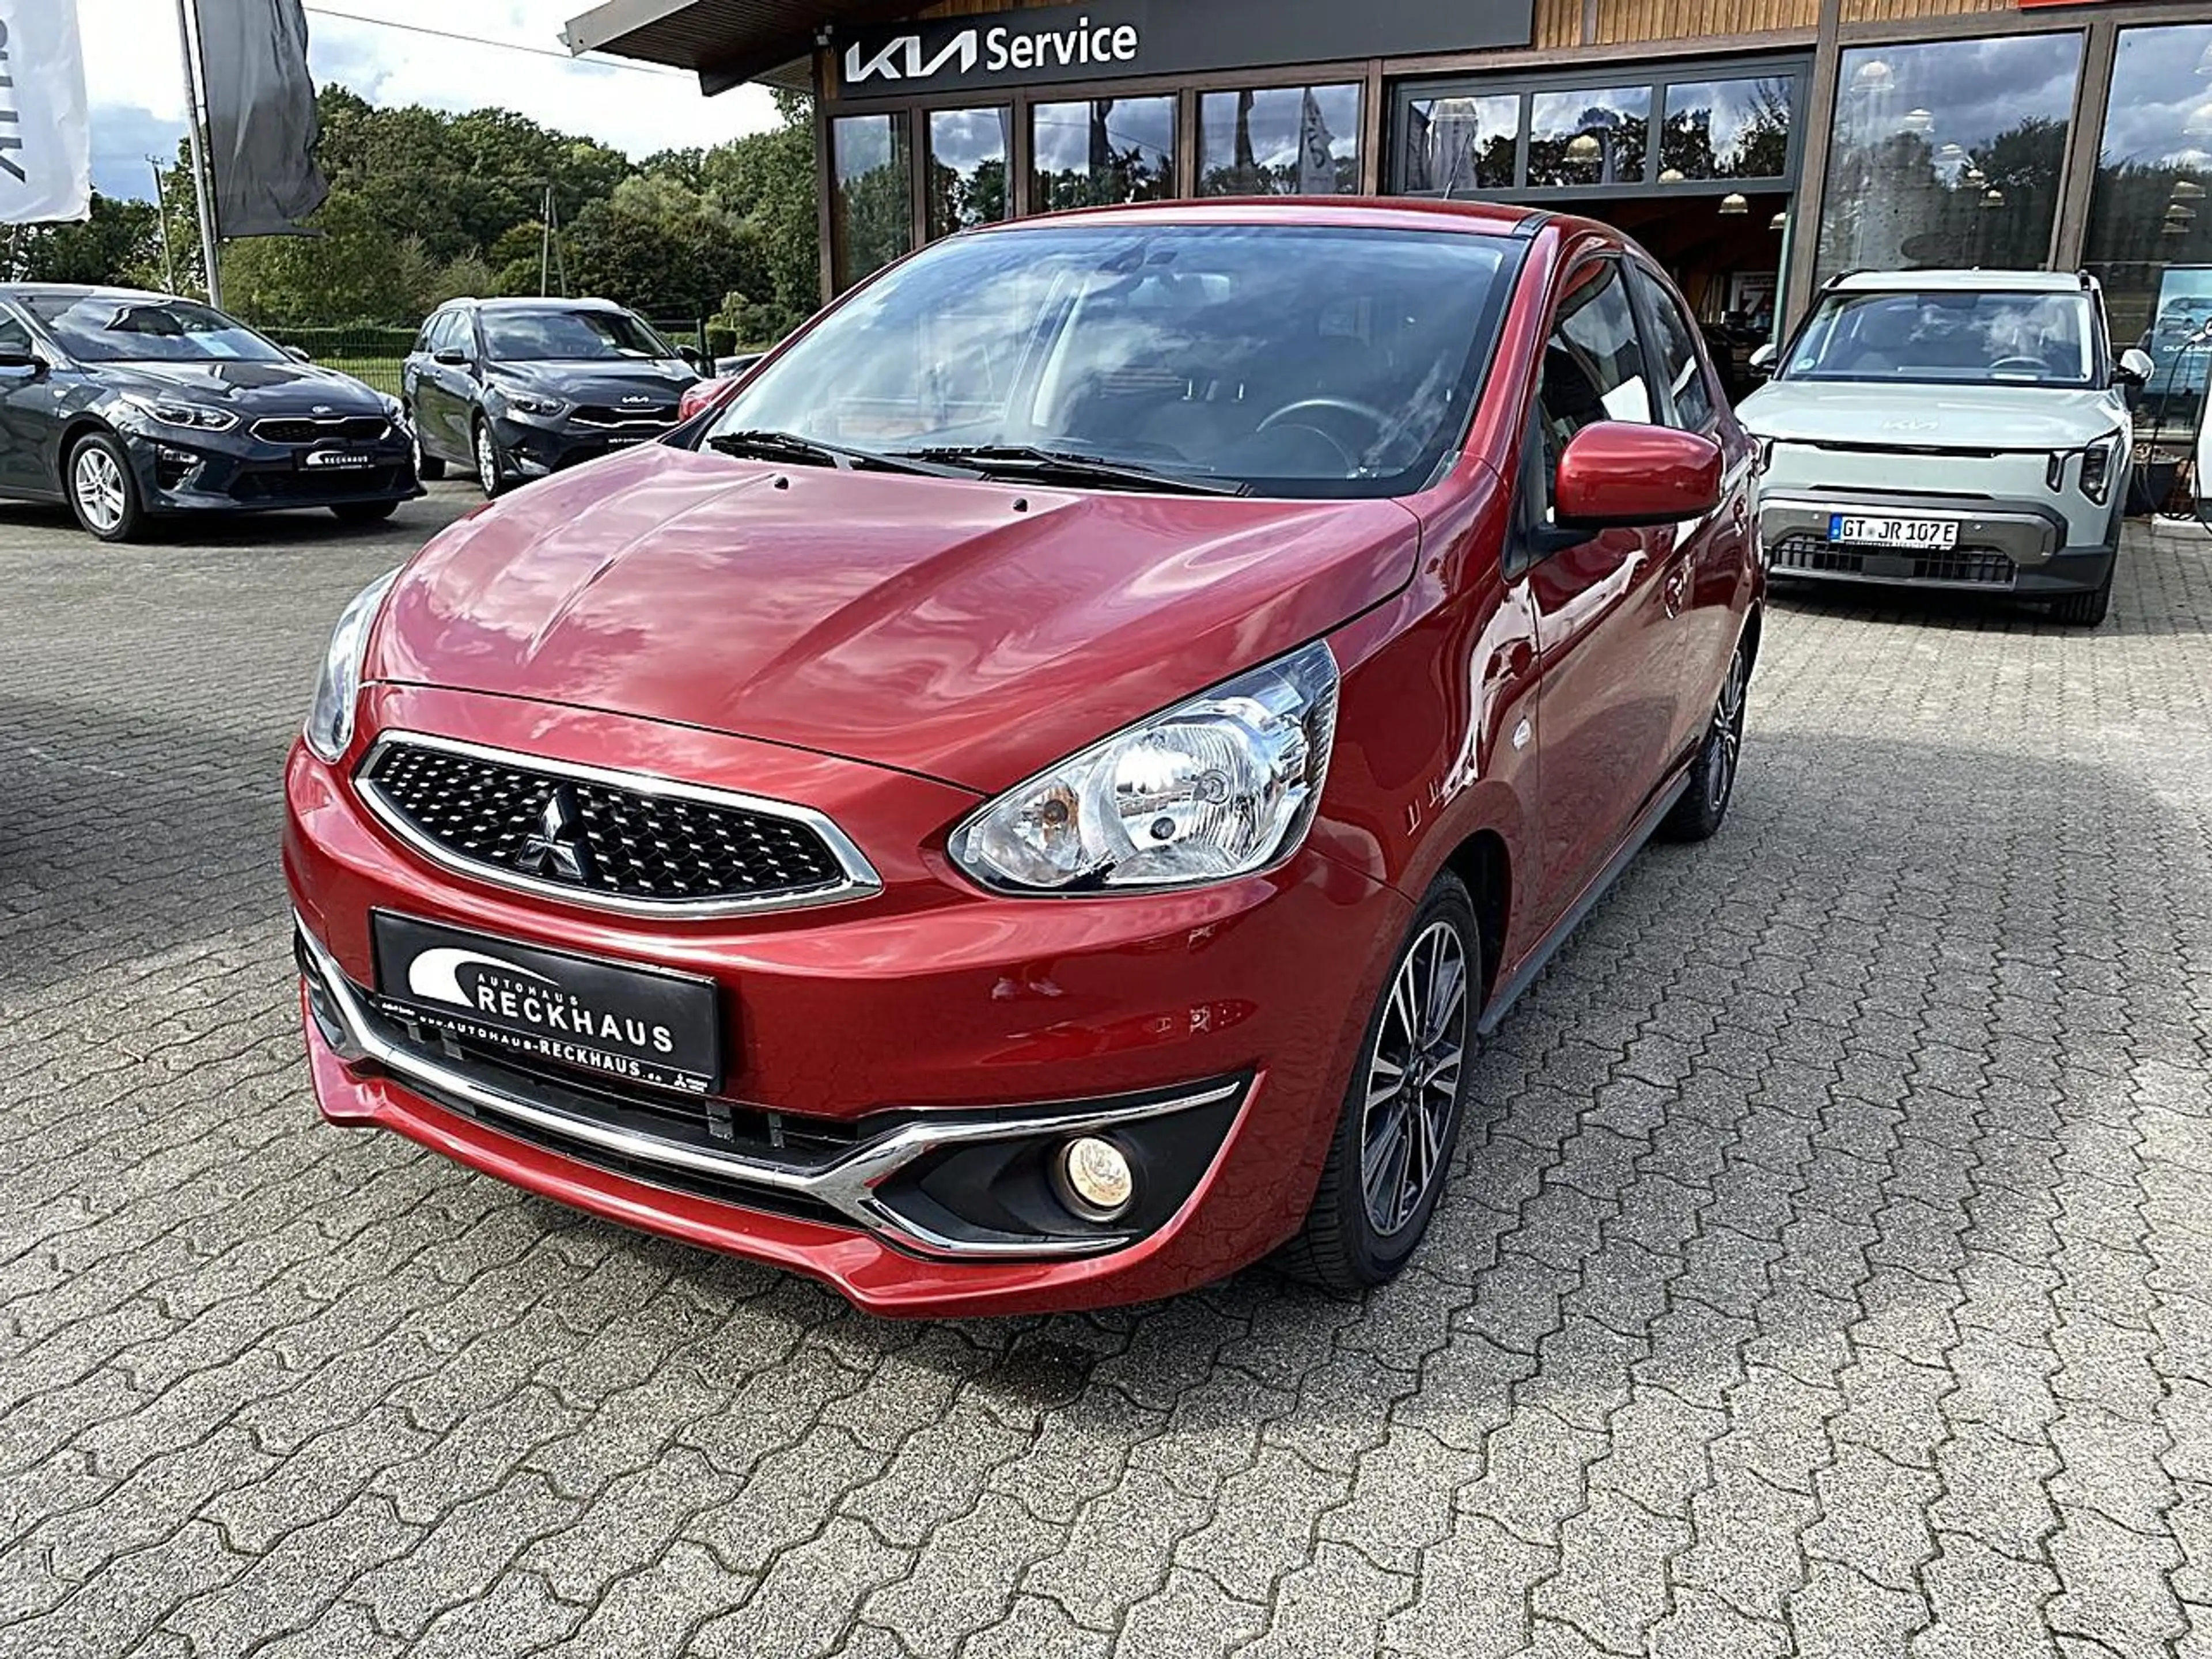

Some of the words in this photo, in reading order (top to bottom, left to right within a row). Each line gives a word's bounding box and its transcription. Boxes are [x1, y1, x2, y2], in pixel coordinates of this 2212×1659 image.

[845, 29, 978, 82] KIA
[986, 16, 1138, 70] Service
[1843, 520, 1866, 538] GT
[1878, 521, 1902, 540] JR
[477, 972, 578, 1006] AUTOHAUS
[476, 984, 674, 1053] RECKHAUS
